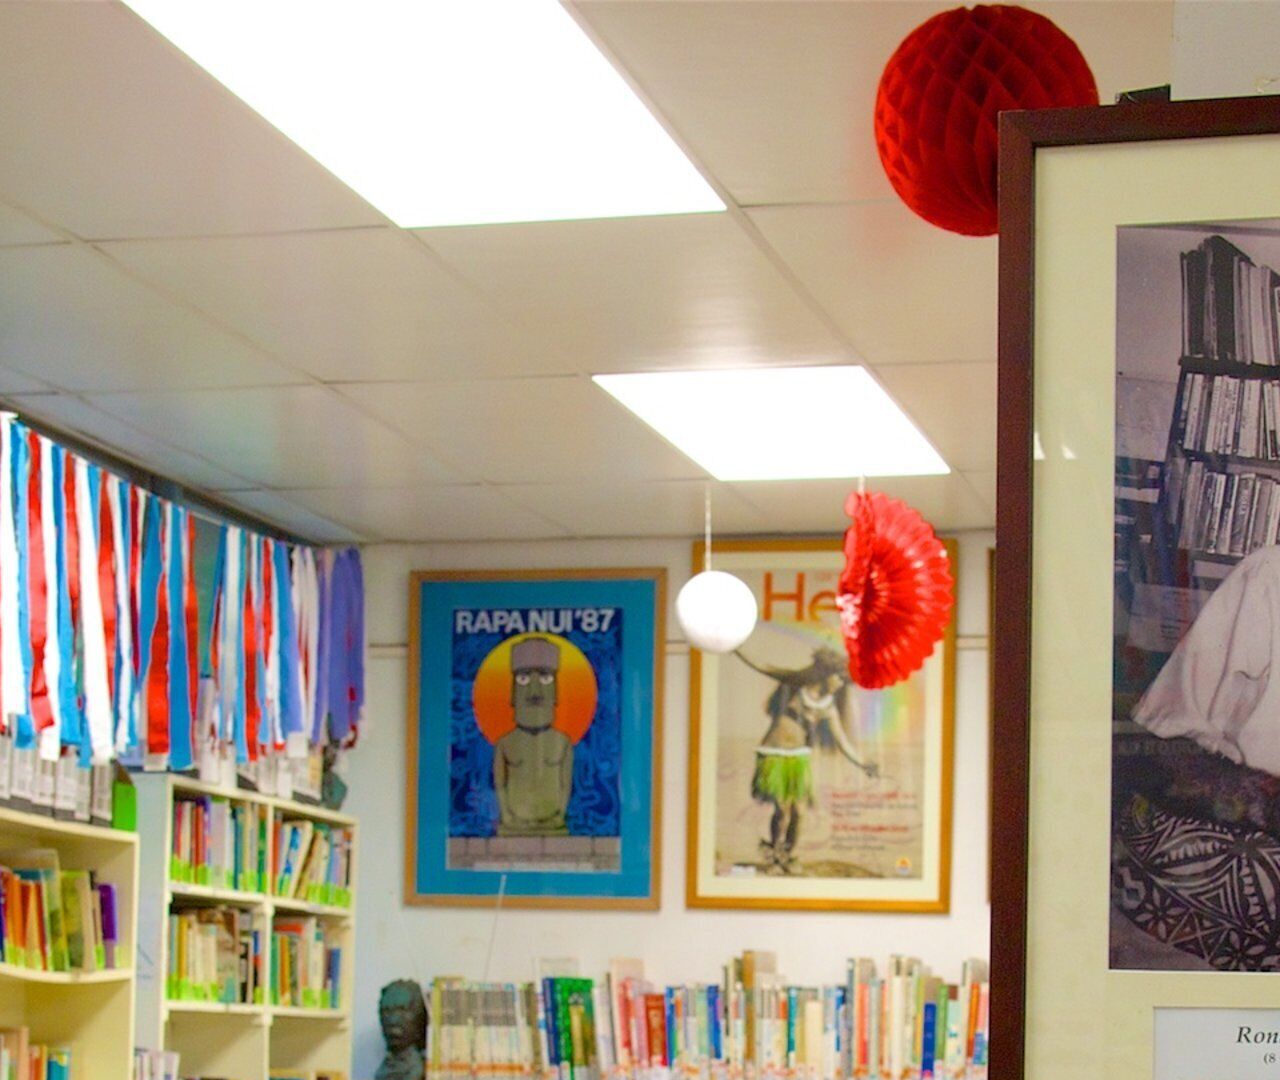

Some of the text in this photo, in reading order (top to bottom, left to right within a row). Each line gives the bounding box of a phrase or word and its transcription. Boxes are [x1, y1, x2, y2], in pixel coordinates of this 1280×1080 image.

[455, 609, 615, 633] RAPA NUI '87
[1263, 1052, 1275, 1063] (8
